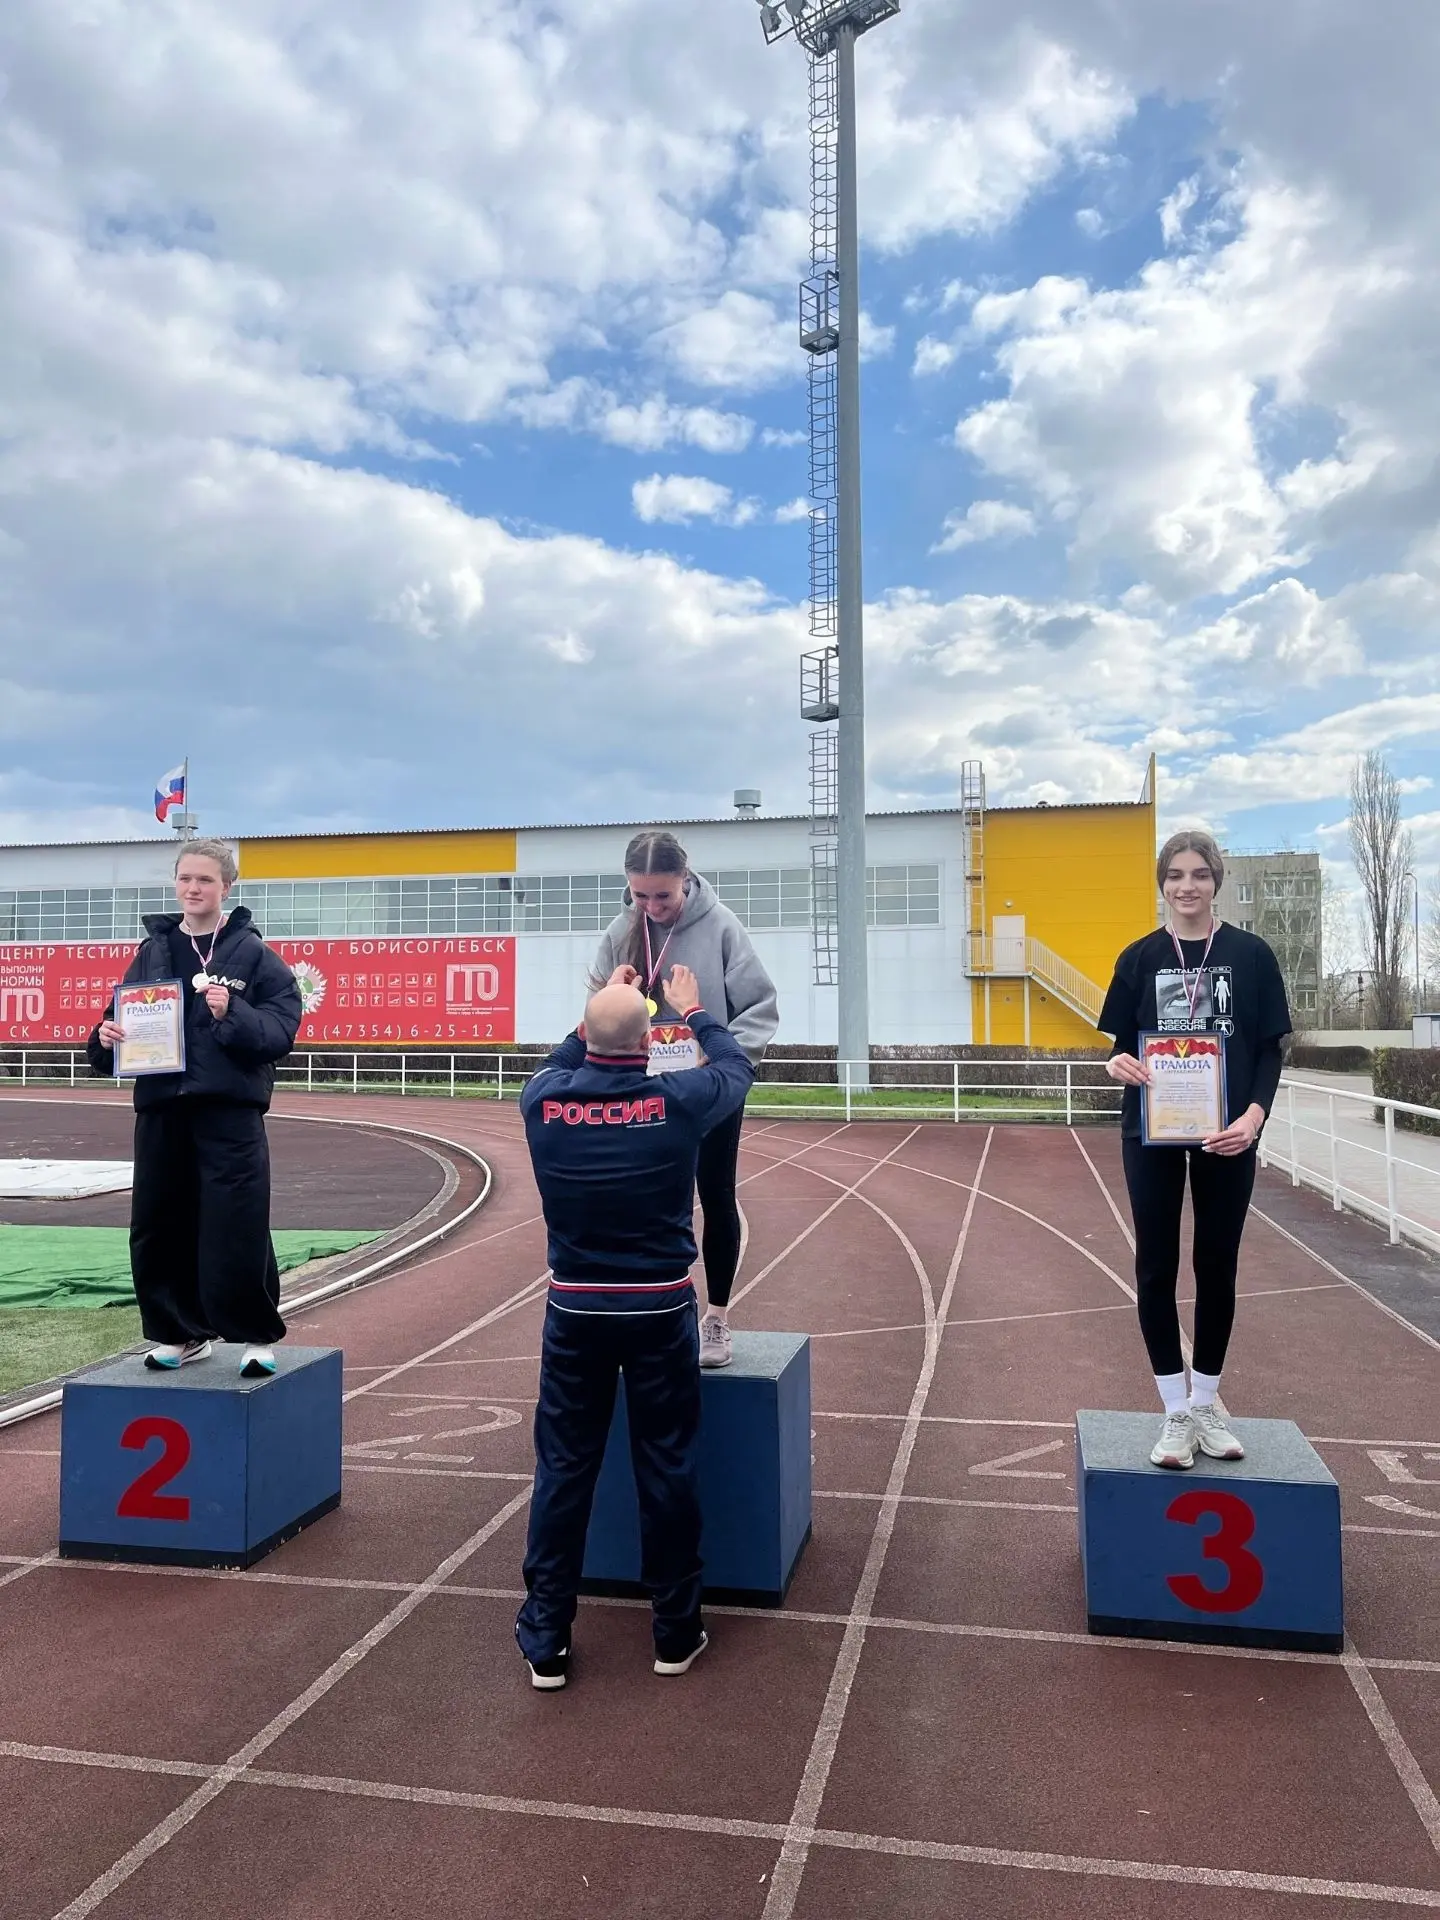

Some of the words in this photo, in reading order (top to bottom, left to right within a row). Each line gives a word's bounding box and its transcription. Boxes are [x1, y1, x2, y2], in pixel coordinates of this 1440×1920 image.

[1, 946, 56, 962] ЦЕНТР
[280, 943, 315, 956] ГТО
[327, 942, 343, 956] Г.
[350, 939, 507, 955] БОРИСОГЛЕБСК
[0, 965, 45, 974] ВЫПОЛНИ
[1157, 967, 1208, 975] MENTALITY
[0, 975, 45, 987] НОРМЫ
[446, 963, 499, 1002] ГТО
[0, 987, 45, 1023] ГТО
[127, 1003, 172, 1016] ГРАМОТА
[9, 1025, 30, 1038] СК
[44, 1024, 94, 1038] "БОР
[306, 1024, 315, 1037] 8
[323, 1023, 402, 1041] (47354)
[410, 1023, 494, 1038] 6-25-12
[1157, 1024, 1207, 1032] INSECURE
[650, 1045, 693, 1056] РАМОТА
[1154, 1059, 1212, 1070] ГРАМОТА
[542, 1096, 667, 1126] РОССИЯ
[117, 1416, 192, 1522] 2
[1165, 1490, 1264, 1613] 3
